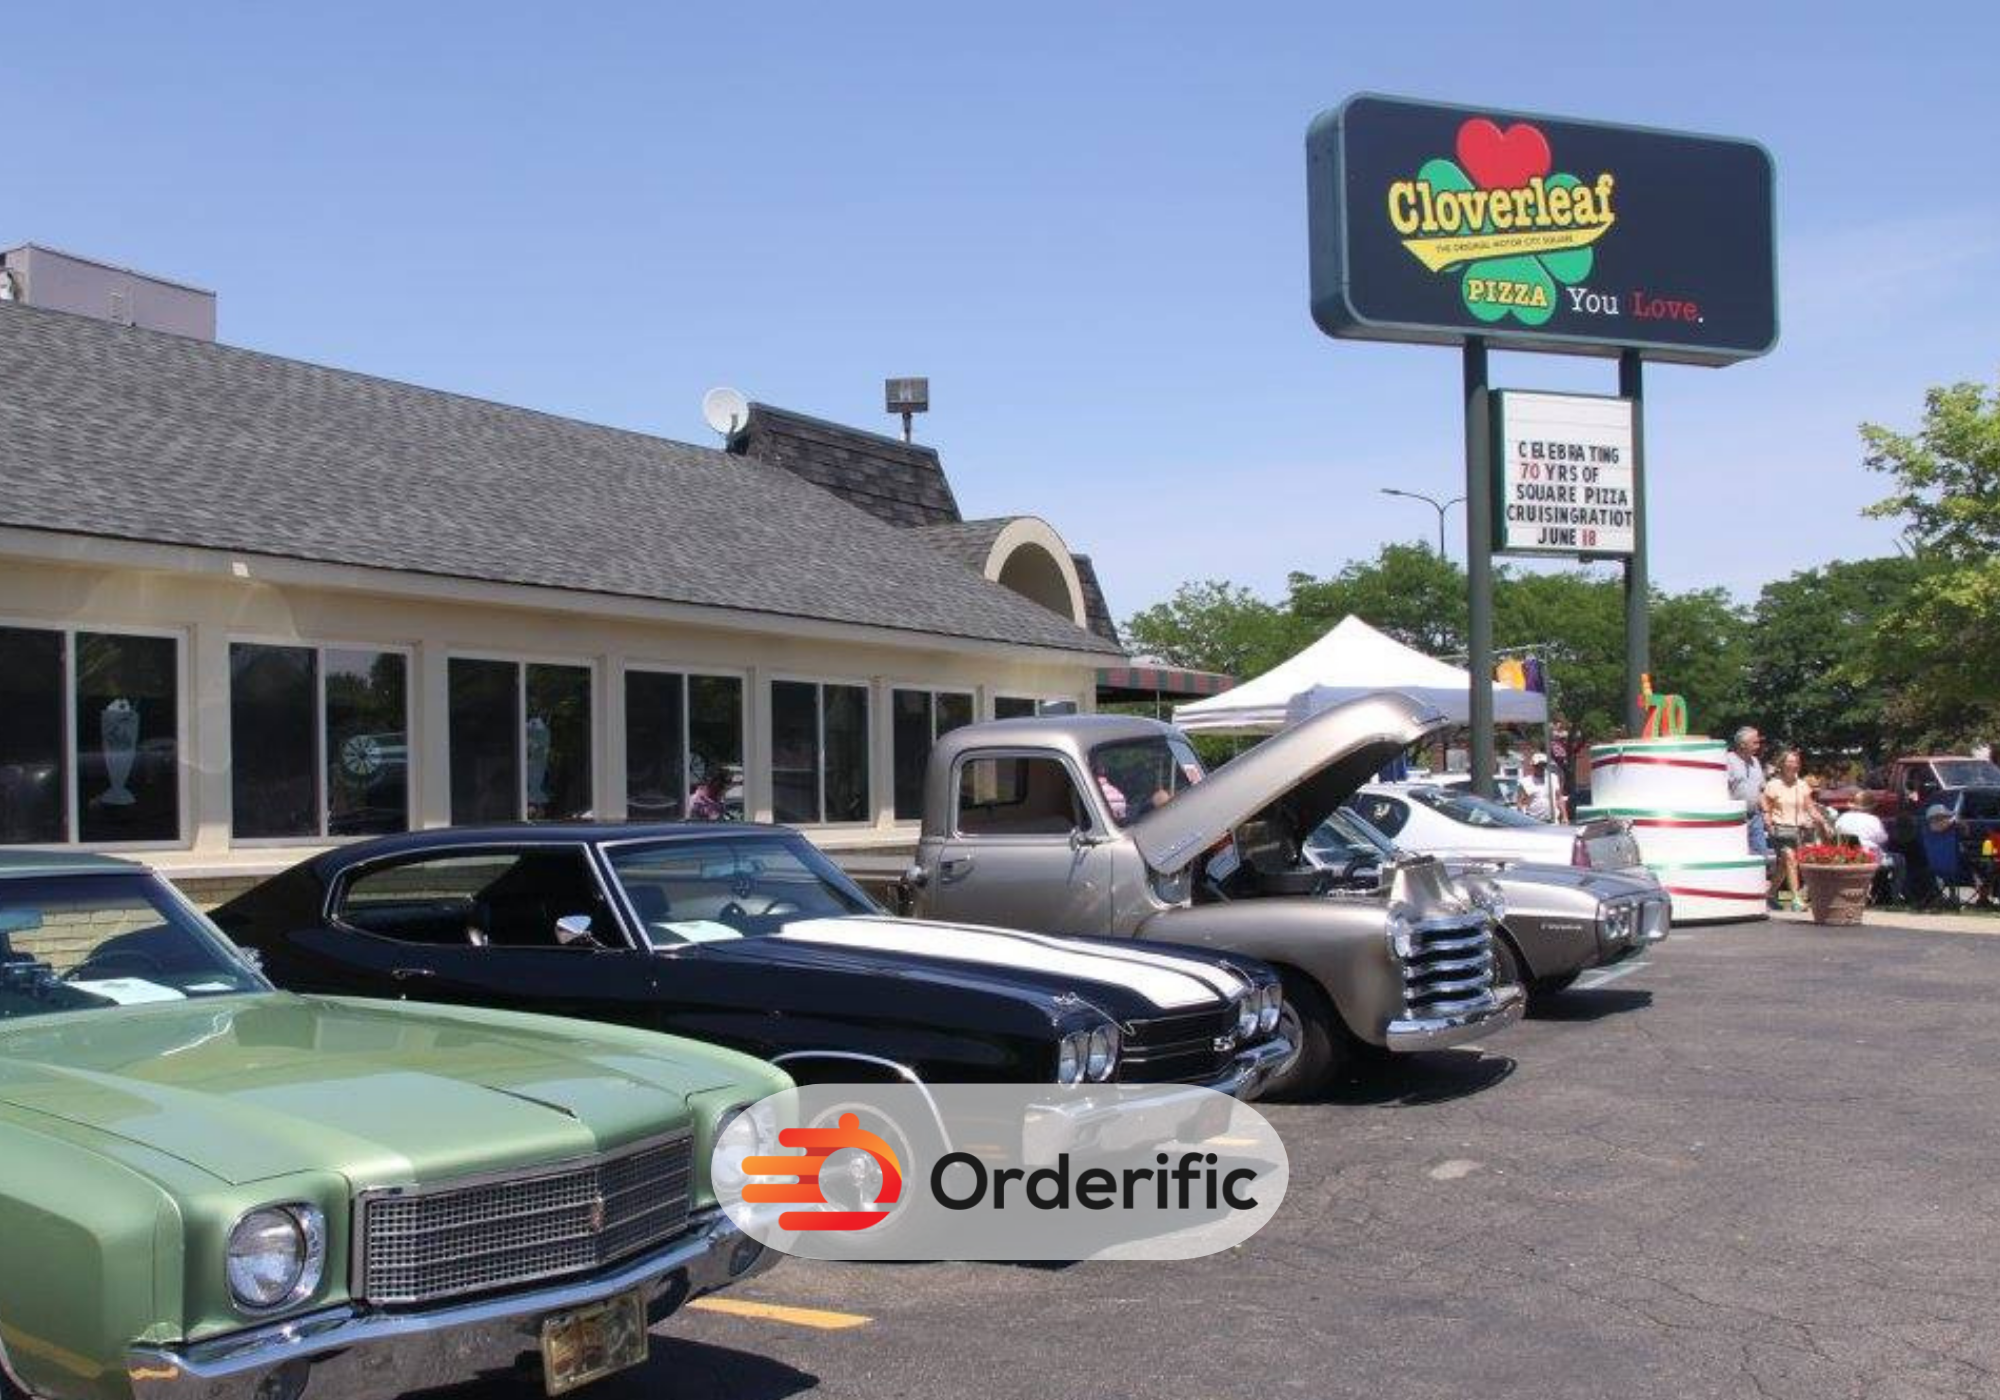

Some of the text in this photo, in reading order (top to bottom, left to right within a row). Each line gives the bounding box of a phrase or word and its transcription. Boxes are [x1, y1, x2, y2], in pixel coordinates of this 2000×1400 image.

[1388, 172, 1615, 234] Cloverleaf
[1435, 243, 1451, 253] THE
[1493, 238, 1522, 248] MOTOR
[1467, 279, 1548, 308] PIZZA
[1566, 286, 1704, 323] You Love.
[1520, 463, 1599, 483] 70 YRS OF
[1516, 484, 1628, 506] SQUARE PIZZA
[1538, 527, 1597, 547] JUNE 18
[1641, 694, 1688, 742] 70
